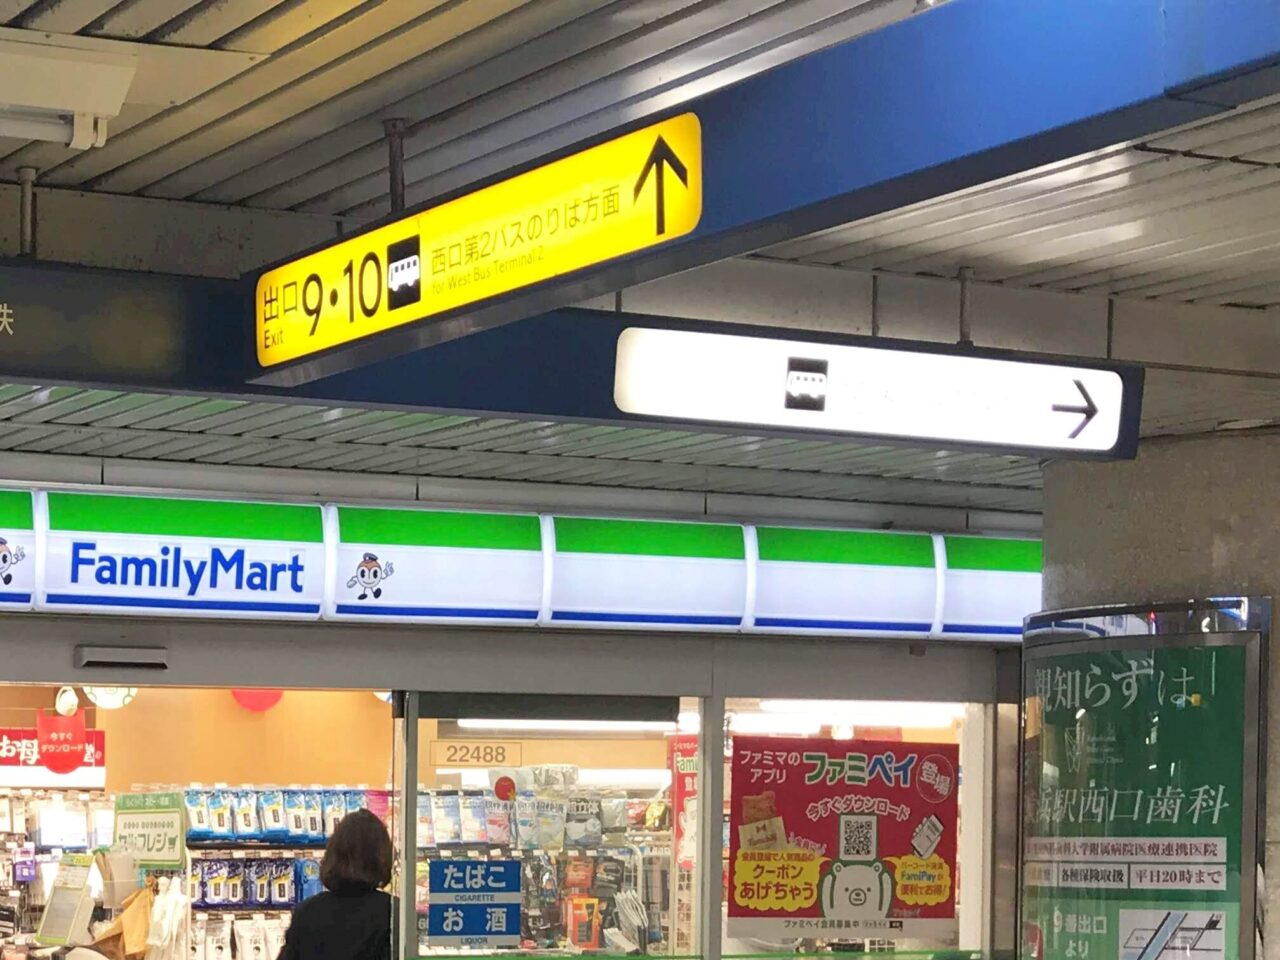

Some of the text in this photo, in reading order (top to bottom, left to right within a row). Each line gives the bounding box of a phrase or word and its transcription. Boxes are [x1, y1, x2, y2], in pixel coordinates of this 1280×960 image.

[447, 271, 471, 290] West
[473, 266, 491, 282] Bus
[493, 251, 536, 275] Terminal
[537, 244, 545, 262] 2
[263, 280, 299, 322] 出口
[263, 329, 285, 350] Exit
[69, 541, 305, 597] FamilyMart
[49, 732, 73, 742] 今すぐ
[41, 743, 84, 753] ダウンロード
[446, 744, 507, 764] 22488
[739, 749, 800, 765] ファミマの
[750, 768, 787, 784] アプリ
[803, 751, 918, 787] ファミペイ
[920, 760, 952, 796] 登場
[805, 794, 911, 822] 今すぐダウンロード
[443, 864, 506, 889] たばこ
[752, 863, 804, 880] クーポン
[1135, 869, 1223, 886] 平日20時まで
[454, 894, 496, 902] CIGARETTE
[739, 880, 815, 900] あげちゃう
[442, 907, 508, 932] お酒
[784, 919, 860, 929] ファミペイ会員募集中
[460, 937, 488, 945] LIQUOR
[1064, 941, 1090, 958] より
